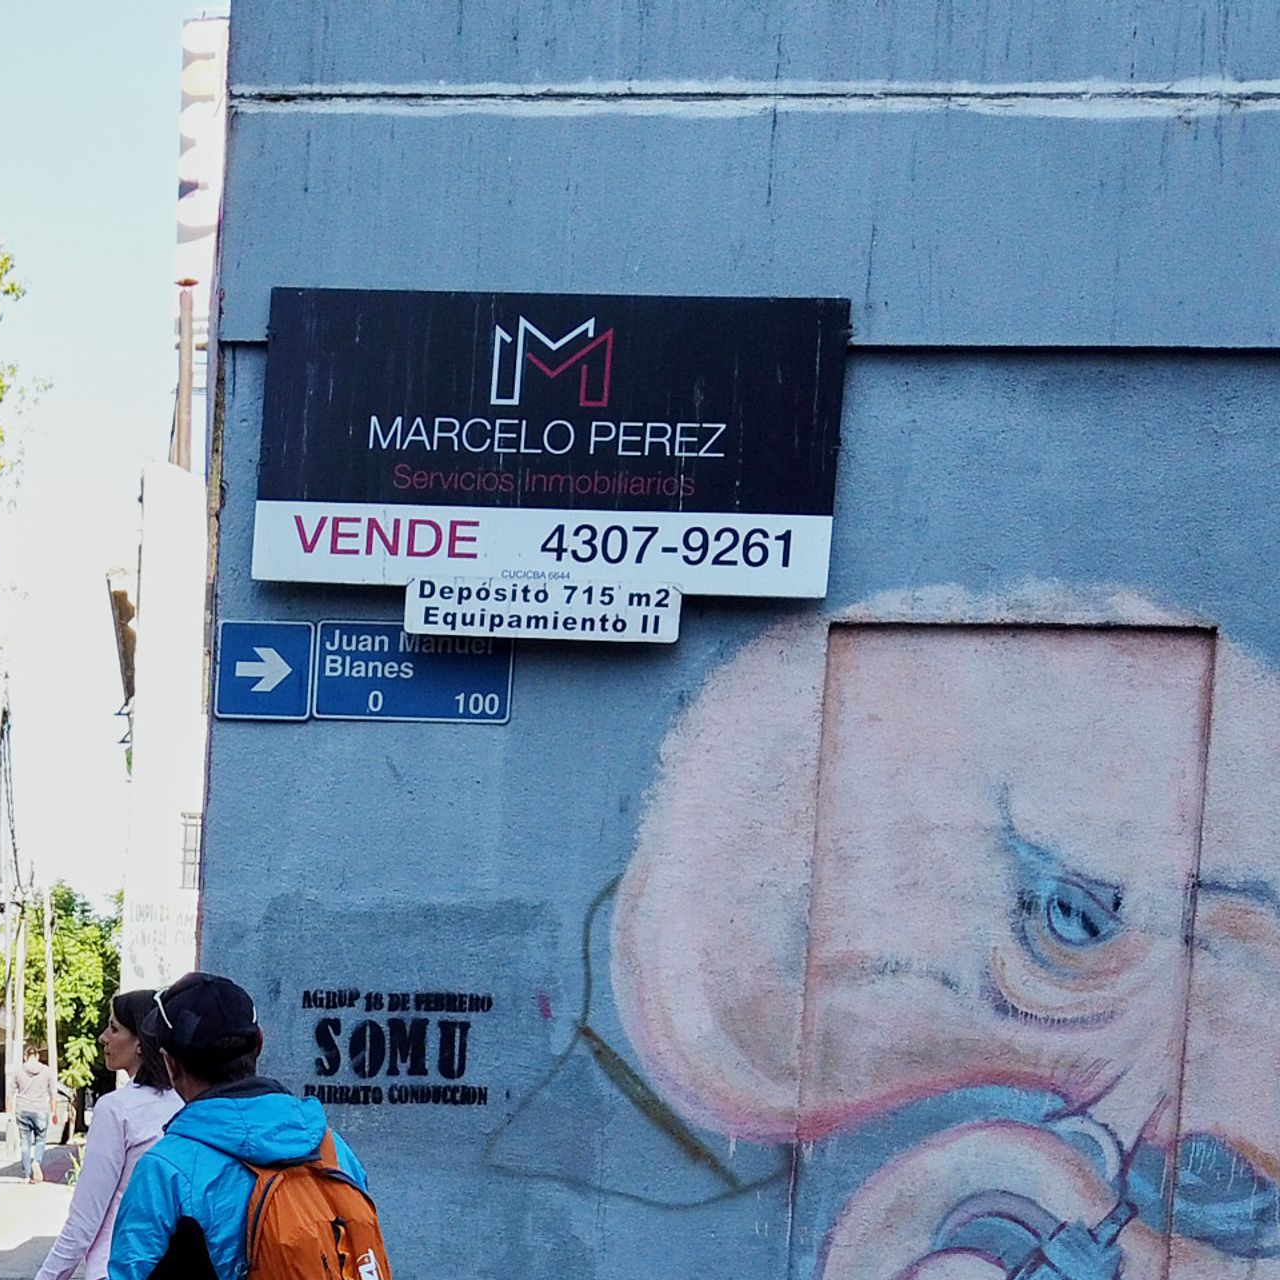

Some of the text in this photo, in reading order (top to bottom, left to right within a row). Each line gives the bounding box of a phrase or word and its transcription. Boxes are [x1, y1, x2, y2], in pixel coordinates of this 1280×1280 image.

[368, 415, 727, 459] MARCELO PEREZ
[392, 463, 696, 498] Servicios Inmobiliarios
[293, 514, 793, 569] VENDE 4307-9261
[501, 568, 546, 580] CUCICBA
[418, 579, 670, 608] Depósito 715 m2
[423, 606, 660, 634] Equipamiento II
[325, 629, 493, 655] Juan Manuel
[324, 654, 415, 679] Blanes
[368, 690, 500, 715] 0 100
[302, 986, 360, 1010] AGRUP
[388, 992, 411, 1012] DE
[414, 991, 494, 1013] FEBRERO
[314, 1017, 471, 1080] SOMU
